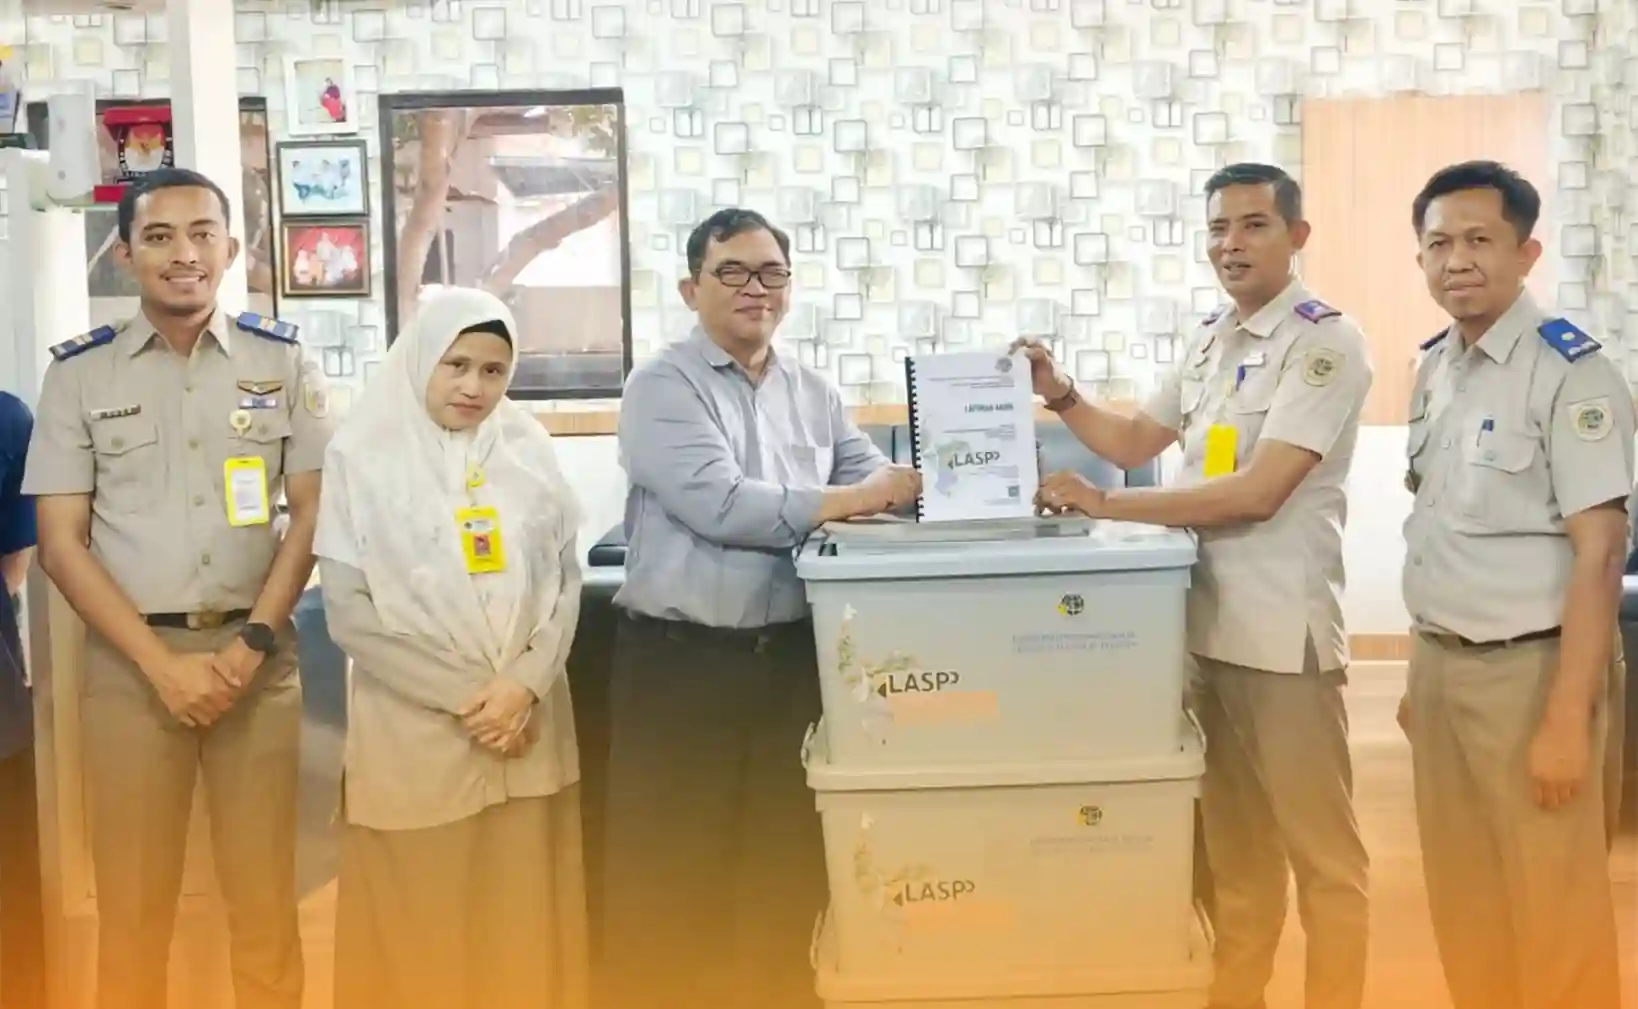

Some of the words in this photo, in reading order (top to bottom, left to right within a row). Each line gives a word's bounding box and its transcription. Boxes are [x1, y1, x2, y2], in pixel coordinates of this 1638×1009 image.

[954, 451, 994, 467] LASP
[889, 671, 950, 693] LASP
[905, 880, 966, 902] LASP
